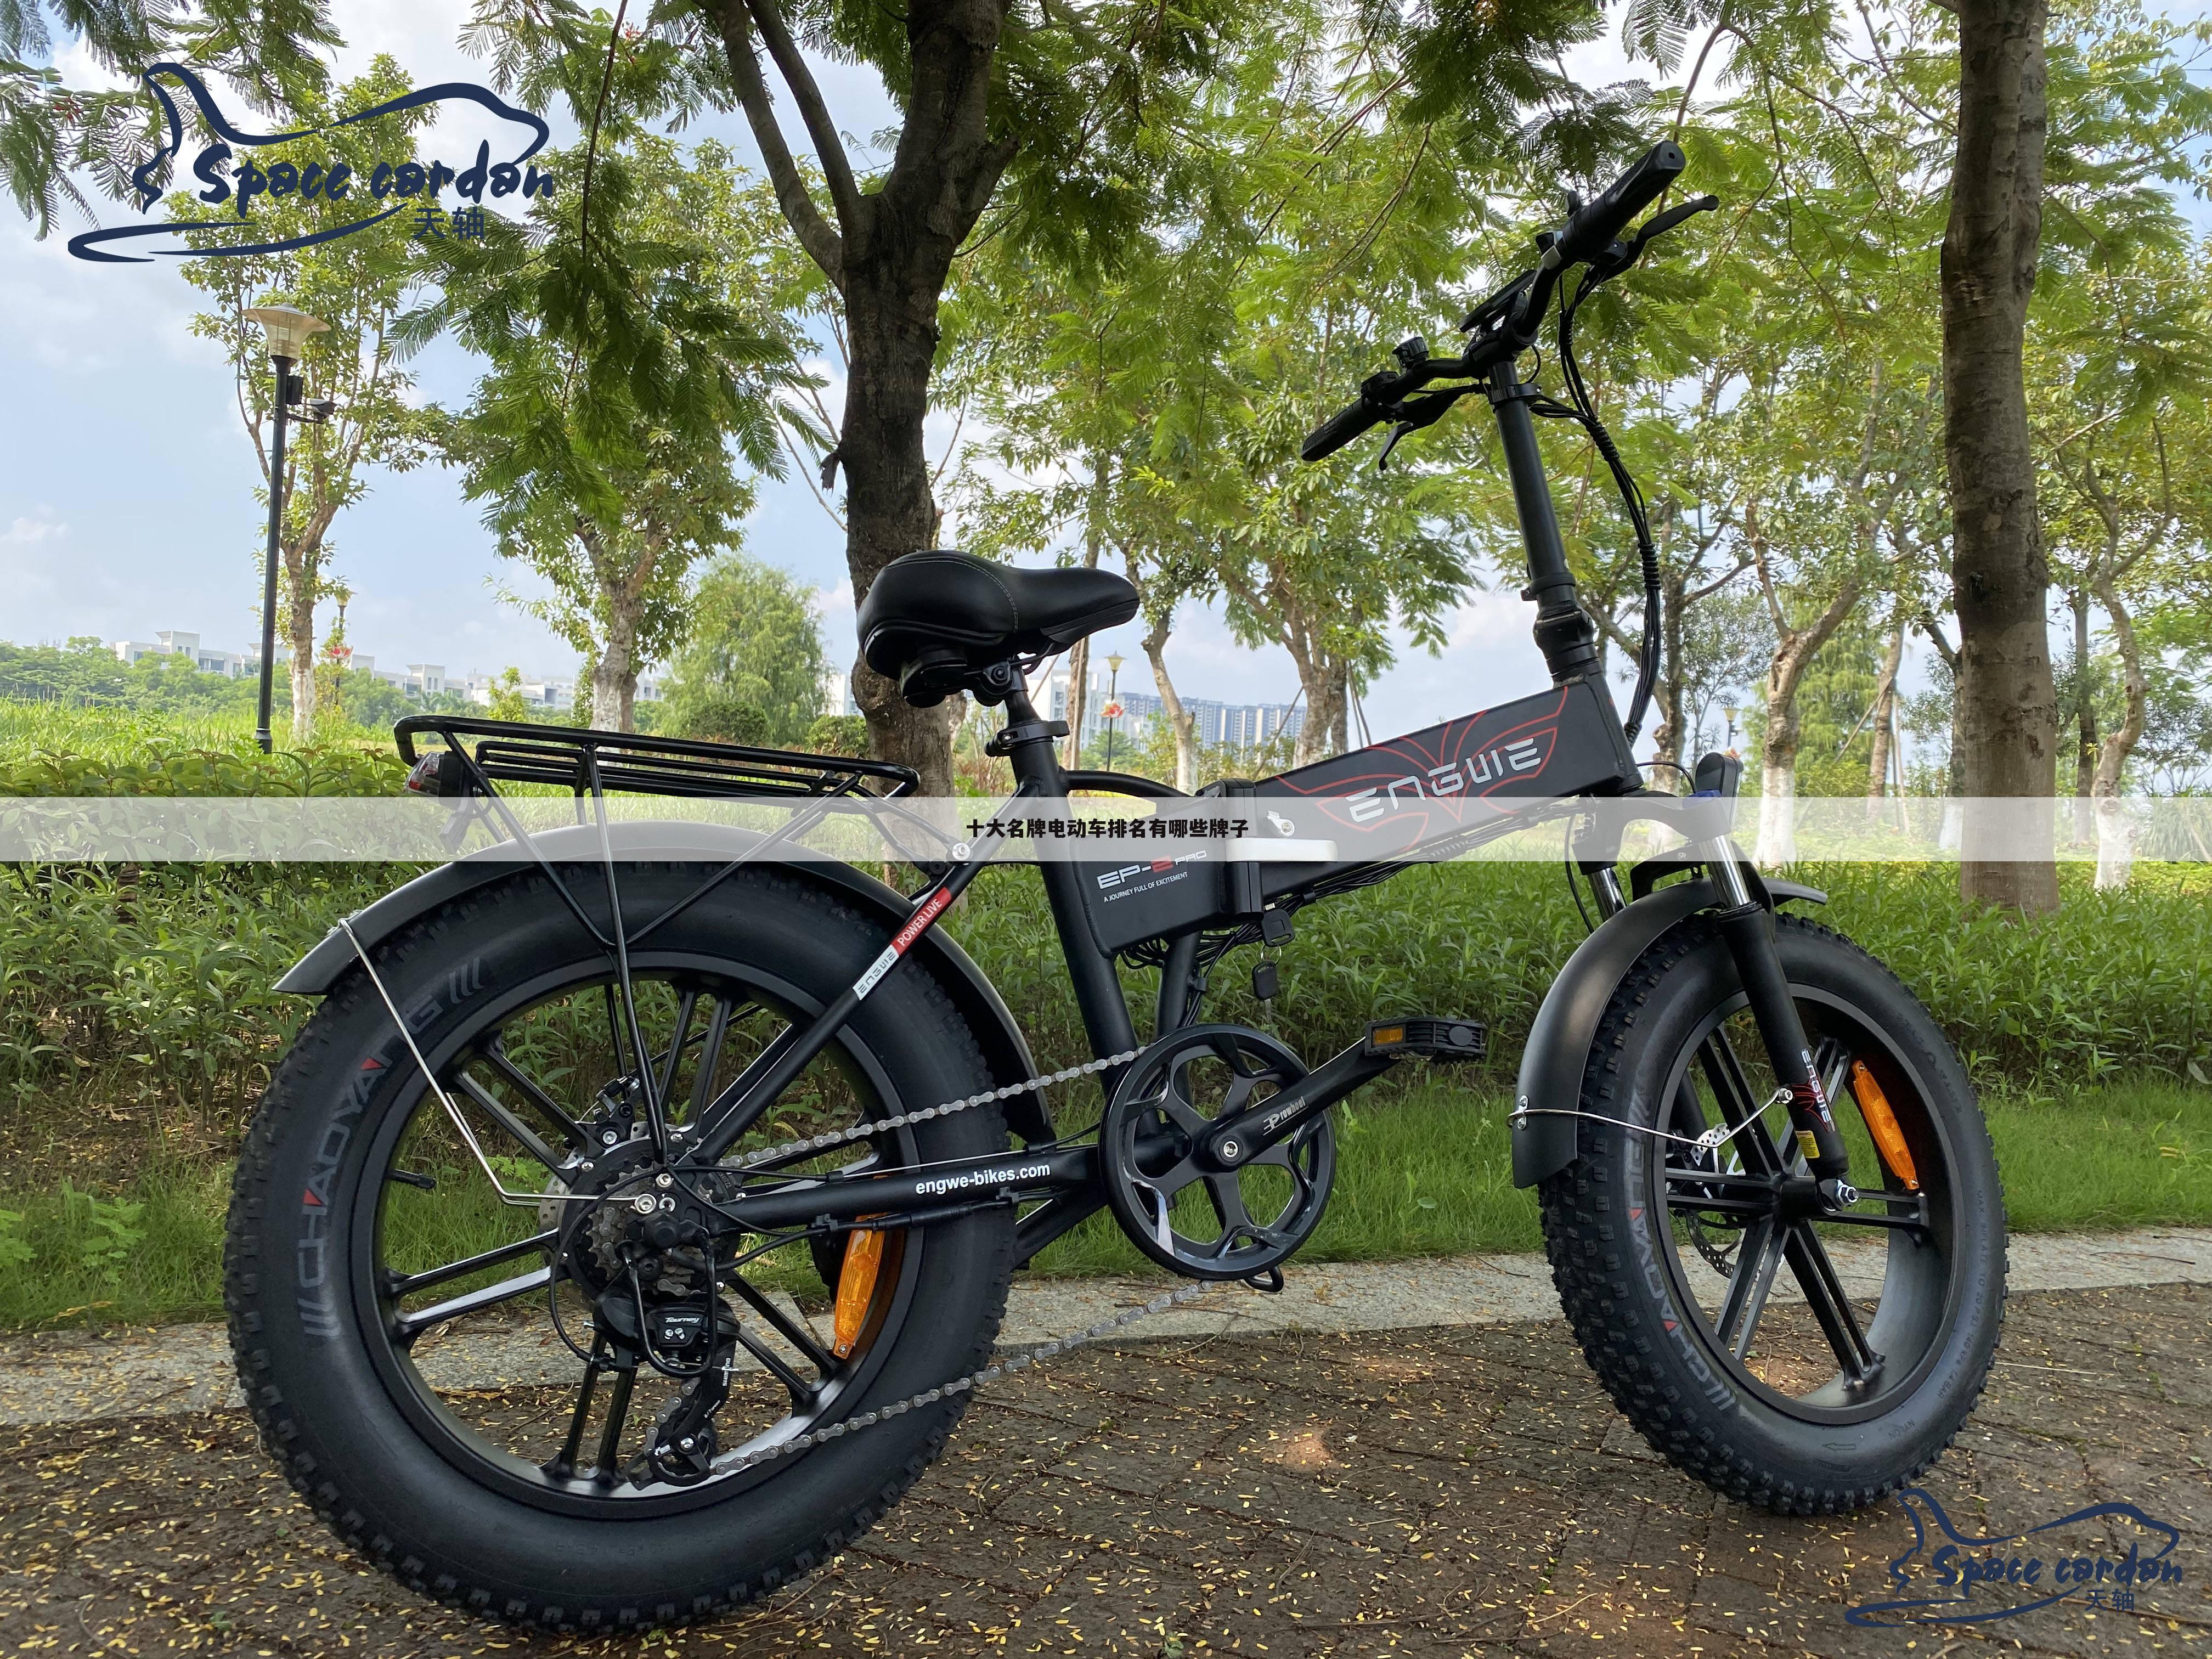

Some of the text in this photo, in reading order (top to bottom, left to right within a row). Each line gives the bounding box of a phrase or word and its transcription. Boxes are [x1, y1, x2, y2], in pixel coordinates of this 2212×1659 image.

[1175, 850, 1207, 866] PRO
[1109, 888, 1133, 901] JOURNEY
[1133, 884, 1148, 894] FULL
[1155, 871, 1188, 887] EXCITEMENT
[897, 898, 943, 947] POWER LIVE
[1263, 1096, 1306, 1130] Prowheel
[916, 1164, 1050, 1194] engwe-bikes.com
[1978, 1273, 1985, 1286] TO
[1888, 1419, 1915, 1440] NYLON
